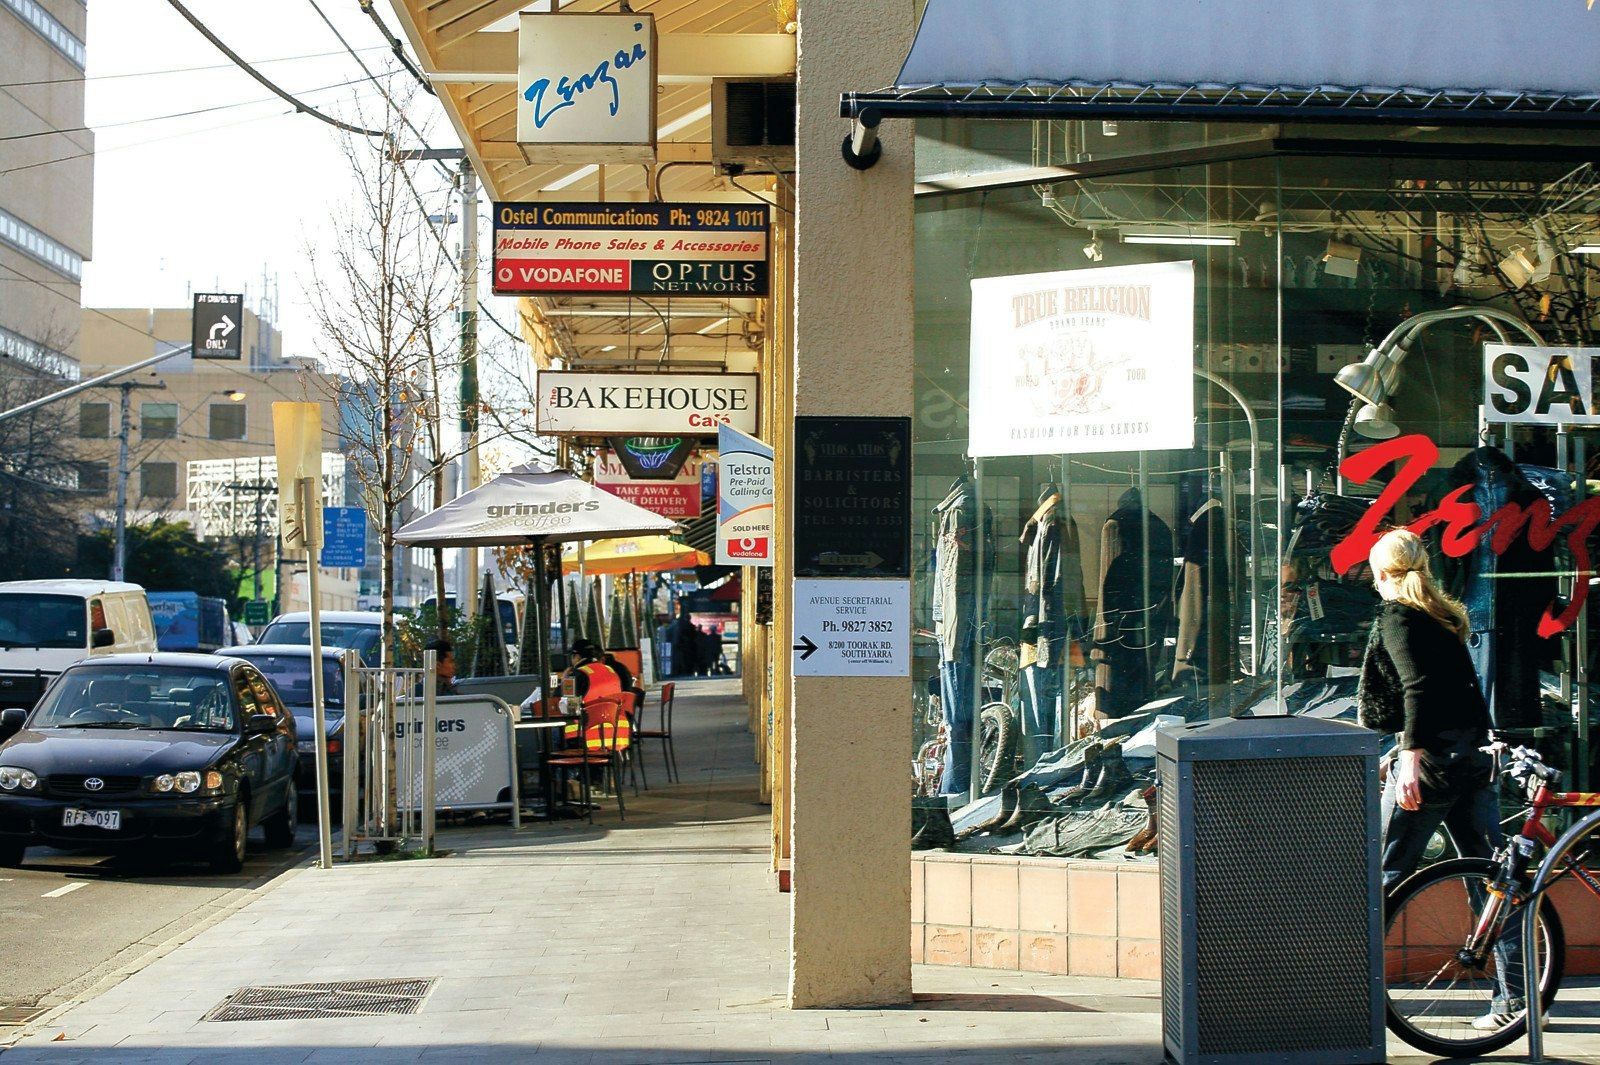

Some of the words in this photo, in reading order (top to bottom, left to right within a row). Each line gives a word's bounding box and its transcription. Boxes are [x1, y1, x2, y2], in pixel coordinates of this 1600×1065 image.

[501, 208, 538, 226] Ostel
[543, 208, 659, 227] Communications
[670, 209, 691, 226] Ph:
[697, 210, 730, 226] 9824
[735, 210, 764, 227] 1011
[498, 238, 549, 251] Mobile
[555, 238, 601, 251] Phone
[607, 239, 647, 251] Sales
[653, 239, 665, 251] &
[672, 239, 760, 253] Accessories
[520, 267, 623, 284] VODAFONE
[652, 262, 757, 281] OPTUS
[653, 281, 756, 292] NETWORK
[1012, 290, 1058, 329] TRUE
[1064, 285, 1151, 321] RELIGION
[206, 339, 228, 349] ONLY
[1126, 368, 1146, 381] TOUR
[555, 386, 748, 411] BAKEHOUSE
[1010, 427, 1054, 440] FASHION
[1061, 426, 1079, 437] FOR
[1084, 424, 1105, 437] THE
[1110, 422, 1149, 436] SENSES
[727, 464, 771, 476] Telstra
[804, 470, 902, 481] BARRISTERS
[730, 478, 766, 486] Pre-Paid
[616, 487, 640, 496] TAKE
[643, 487, 670, 496] AWAY
[673, 488, 681, 496] &
[730, 487, 760, 498] Calling
[847, 485, 857, 495] &
[640, 497, 688, 505] DELIVERY
[804, 497, 901, 509] SOLICITORS
[487, 501, 600, 519] grinders
[662, 507, 686, 515] 5355
[514, 516, 572, 528] coffee
[810, 597, 840, 605] AVENUE
[842, 597, 892, 605] SECRETARIAL
[836, 606, 867, 615] SERVICE
[822, 620, 840, 632] Ph.
[842, 620, 866, 633] 9827
[868, 621, 893, 633] 3852
[828, 641, 845, 650] 8/200
[847, 641, 879, 650] TOORAK
[880, 641, 893, 650] RD.
[841, 650, 867, 658] SOUTH
[867, 650, 892, 658] YARRA
[96, 812, 118, 826] 097
